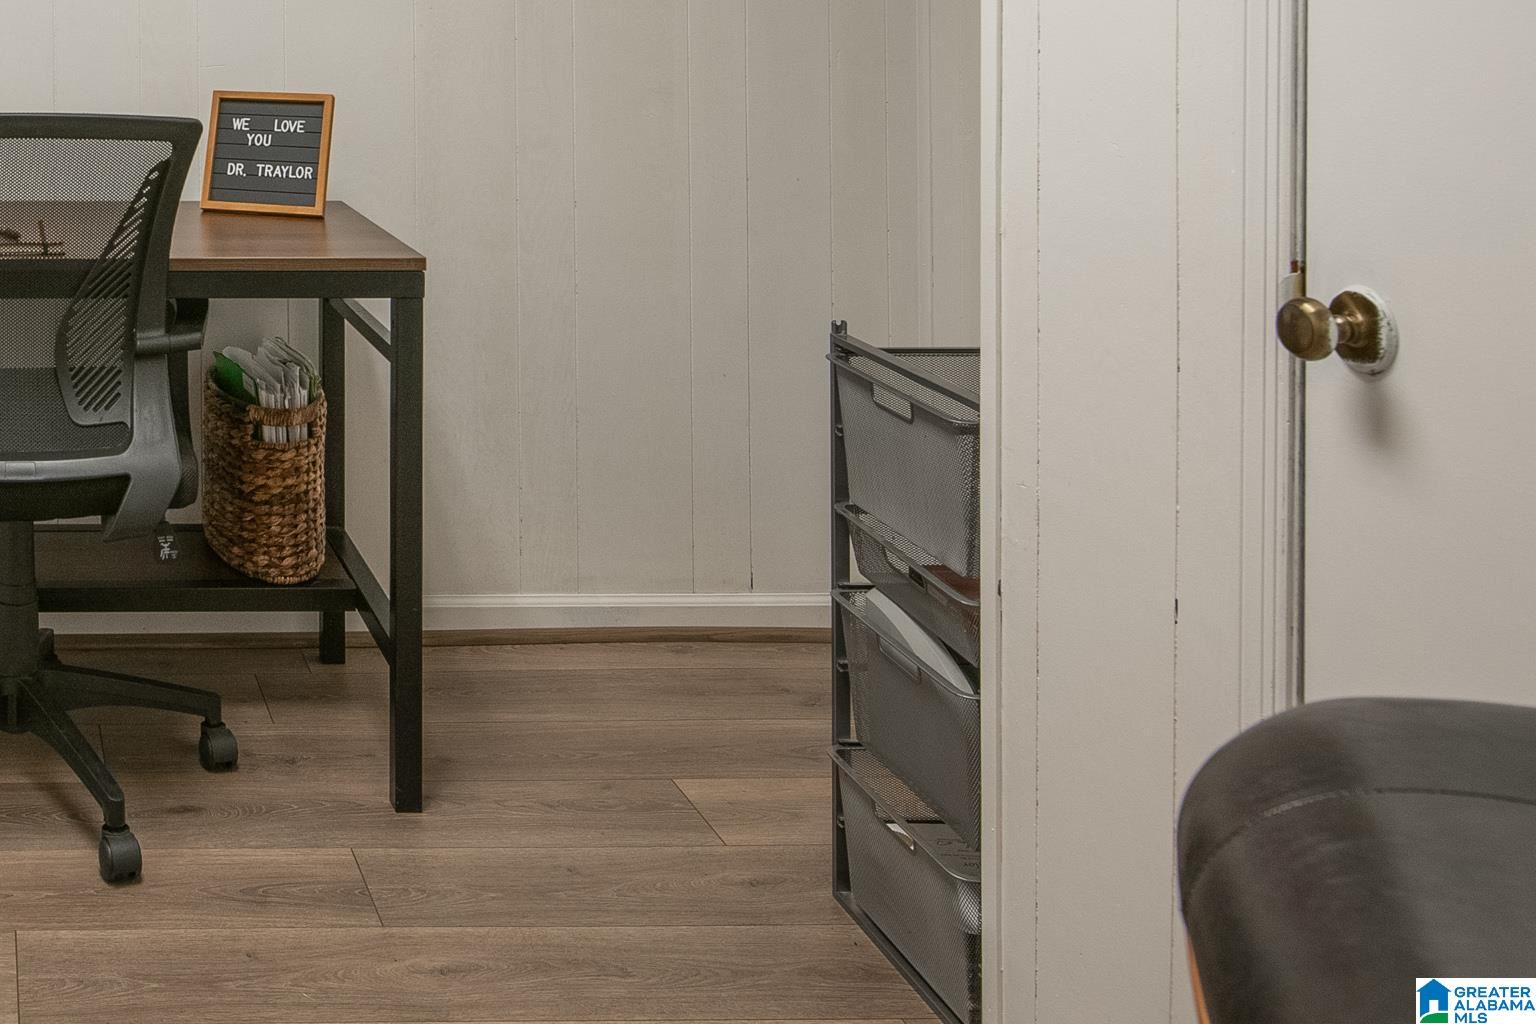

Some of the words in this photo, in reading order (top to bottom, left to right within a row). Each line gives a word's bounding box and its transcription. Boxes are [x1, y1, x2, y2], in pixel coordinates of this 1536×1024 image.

[232, 118, 251, 131] WE
[274, 119, 306, 133] LOVE
[246, 133, 272, 147] YOU
[226, 163, 247, 177] DR.
[256, 164, 313, 179] TRAYLOR
